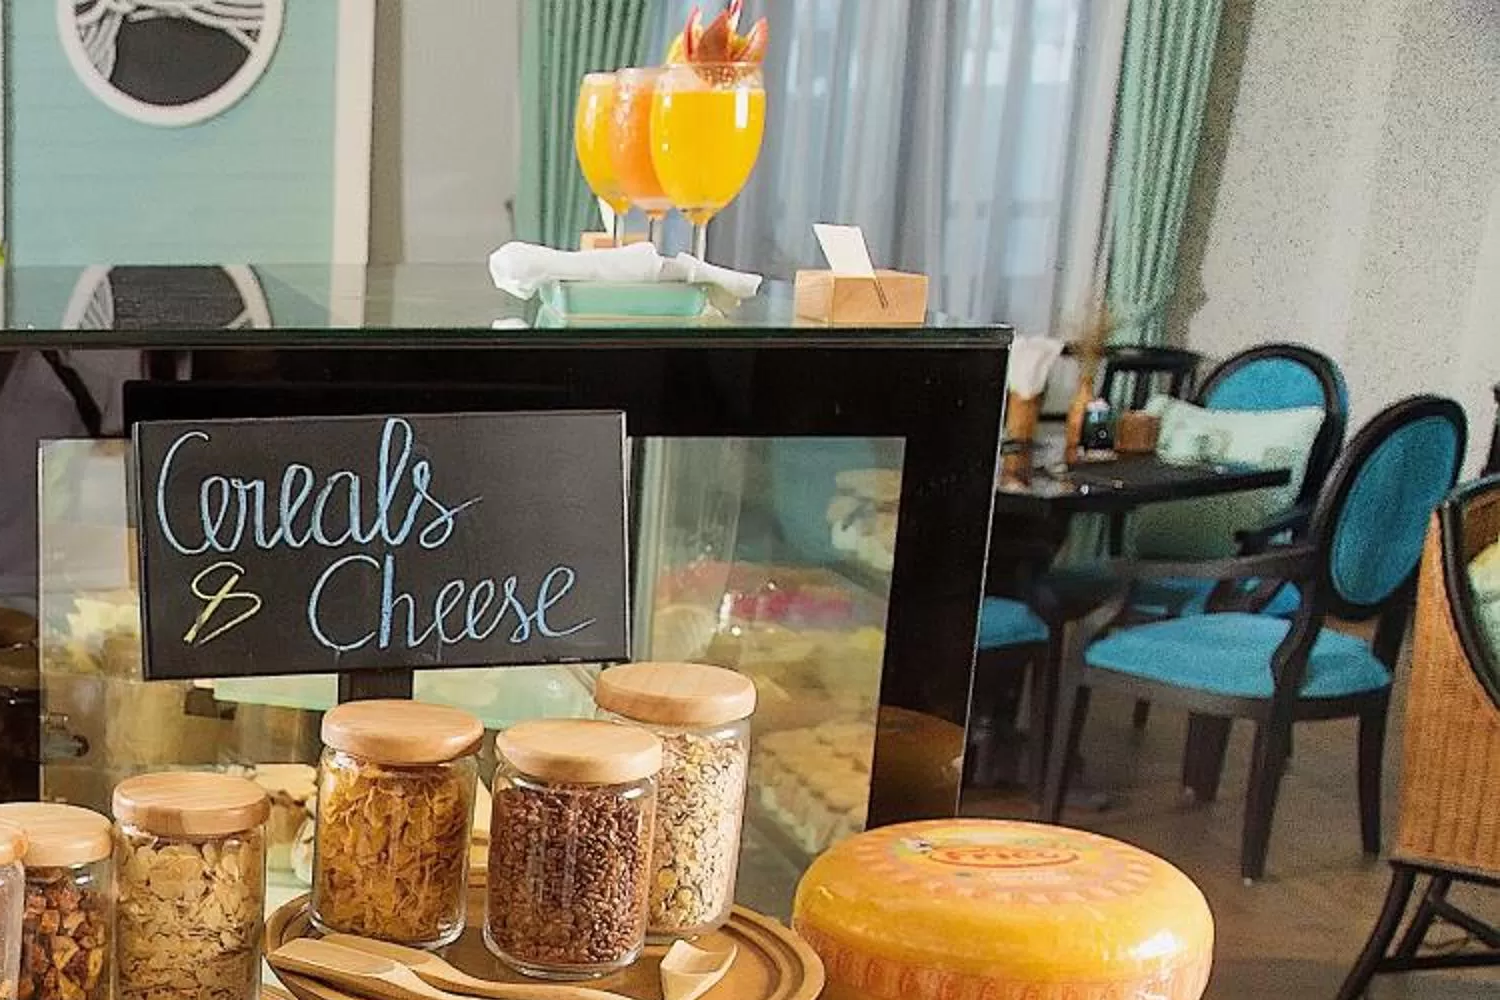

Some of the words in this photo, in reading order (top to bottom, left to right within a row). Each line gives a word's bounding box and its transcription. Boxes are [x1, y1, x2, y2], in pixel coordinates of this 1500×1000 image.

[156, 416, 484, 555] Cereals
[182, 560, 263, 649] &
[307, 552, 597, 652] Cheese
